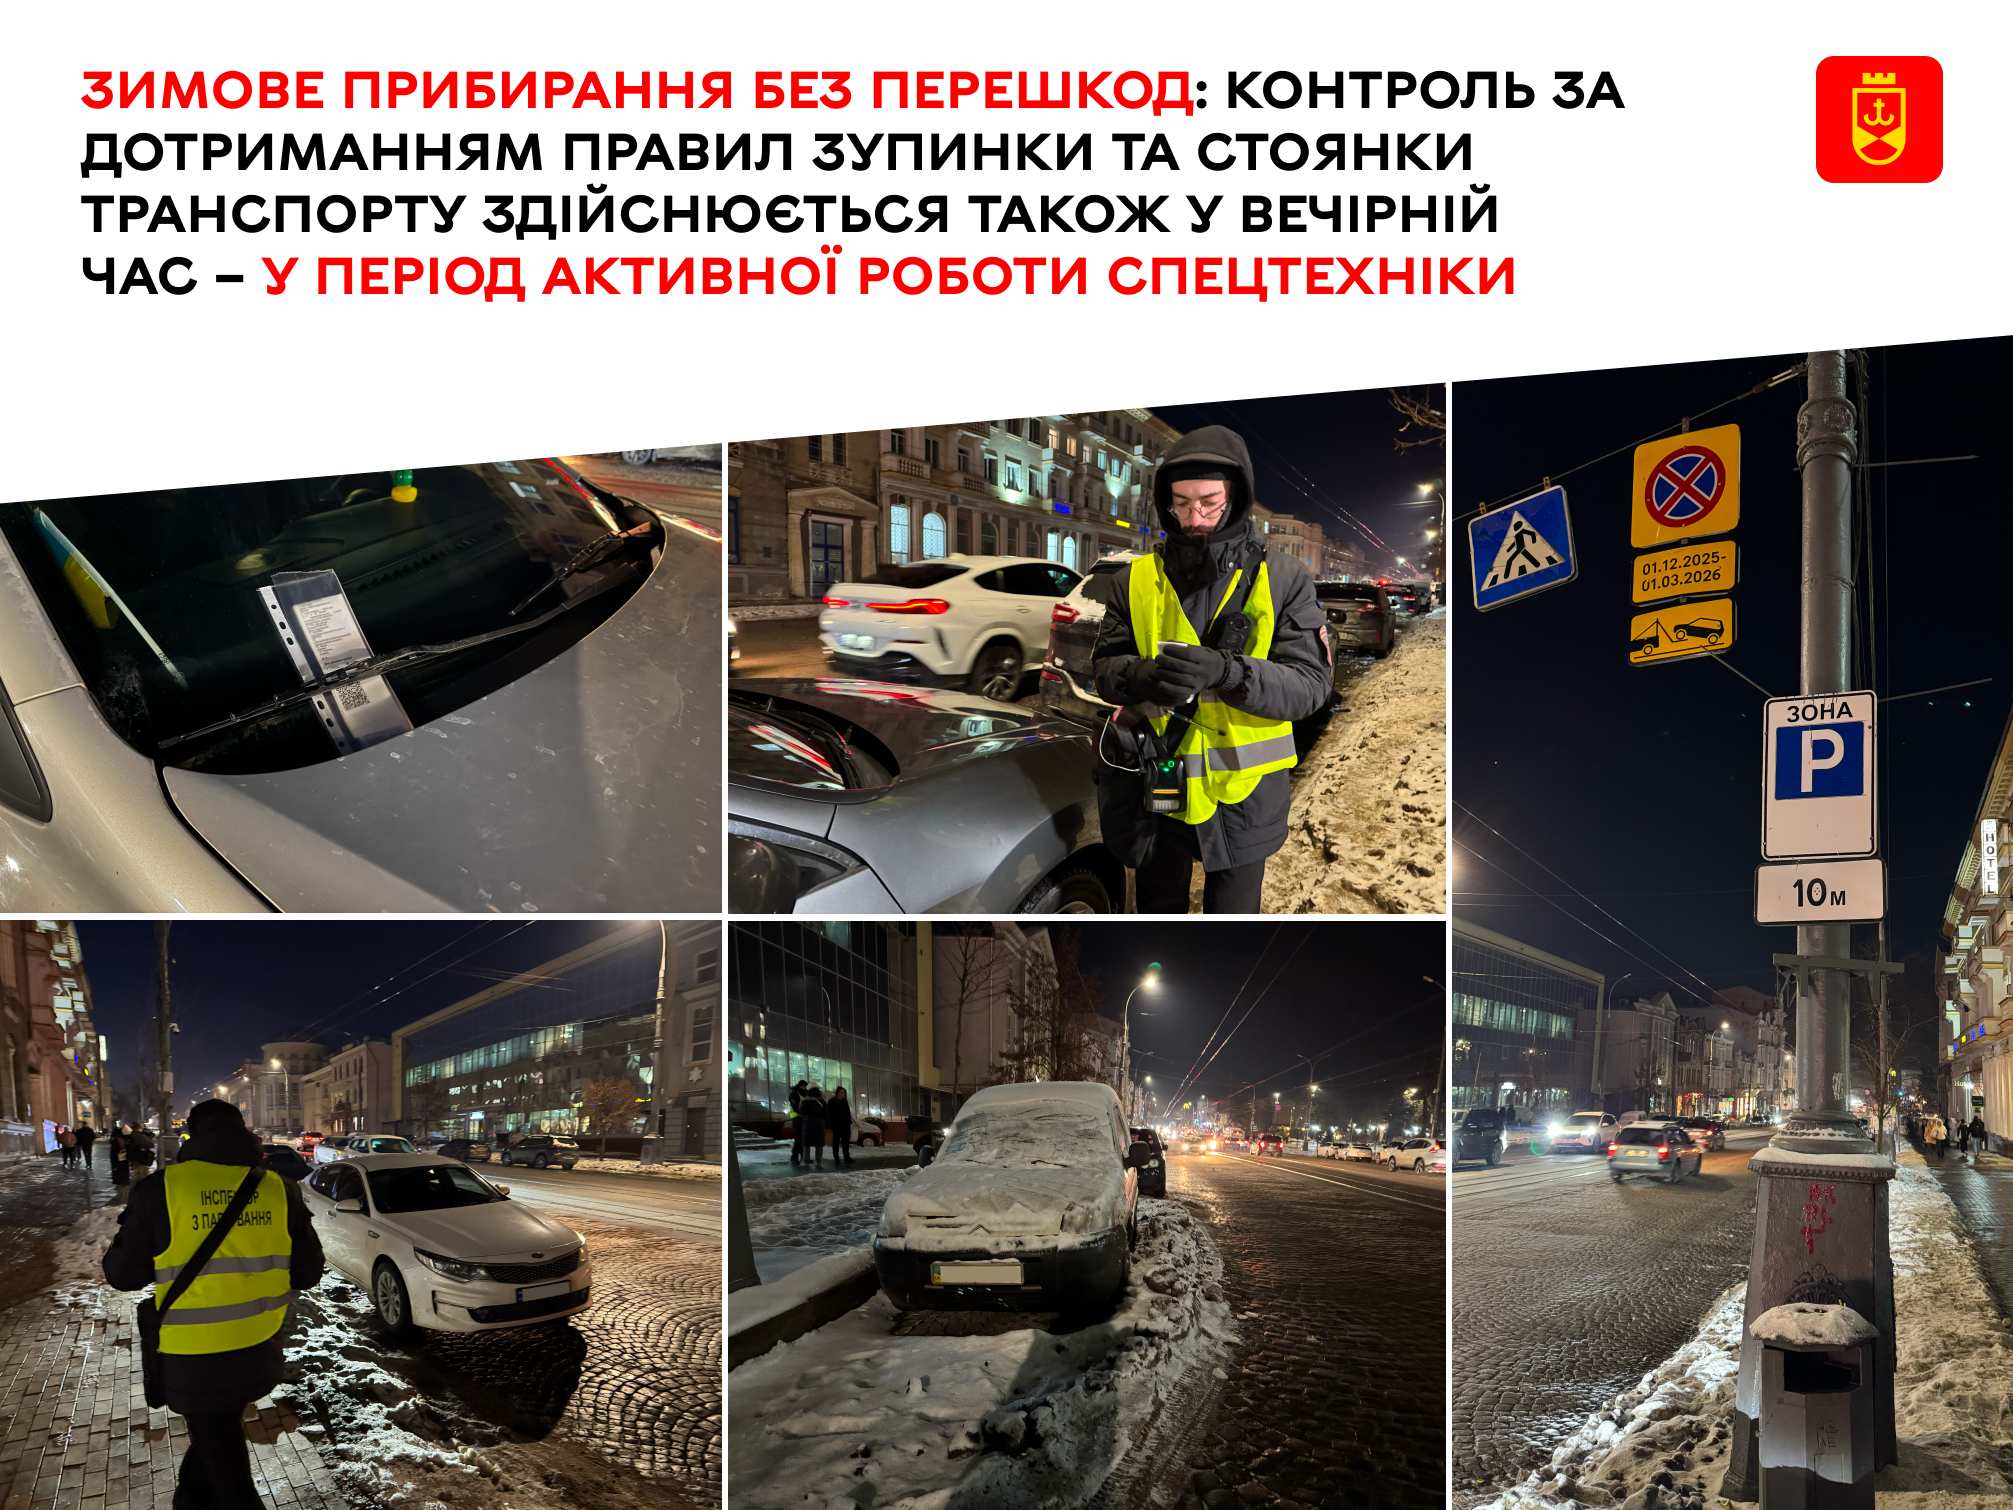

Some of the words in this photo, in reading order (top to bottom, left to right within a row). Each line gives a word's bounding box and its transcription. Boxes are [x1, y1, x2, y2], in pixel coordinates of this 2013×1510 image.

[1642, 551, 1727, 575] 01.12.2025-
[1641, 566, 1721, 591] 01.03.2026
[1786, 701, 1853, 723] ЗОНА
[1801, 728, 1845, 793] P
[1985, 832, 1996, 893] HOTEL
[201, 1189, 259, 1206] ІНСПЕР
